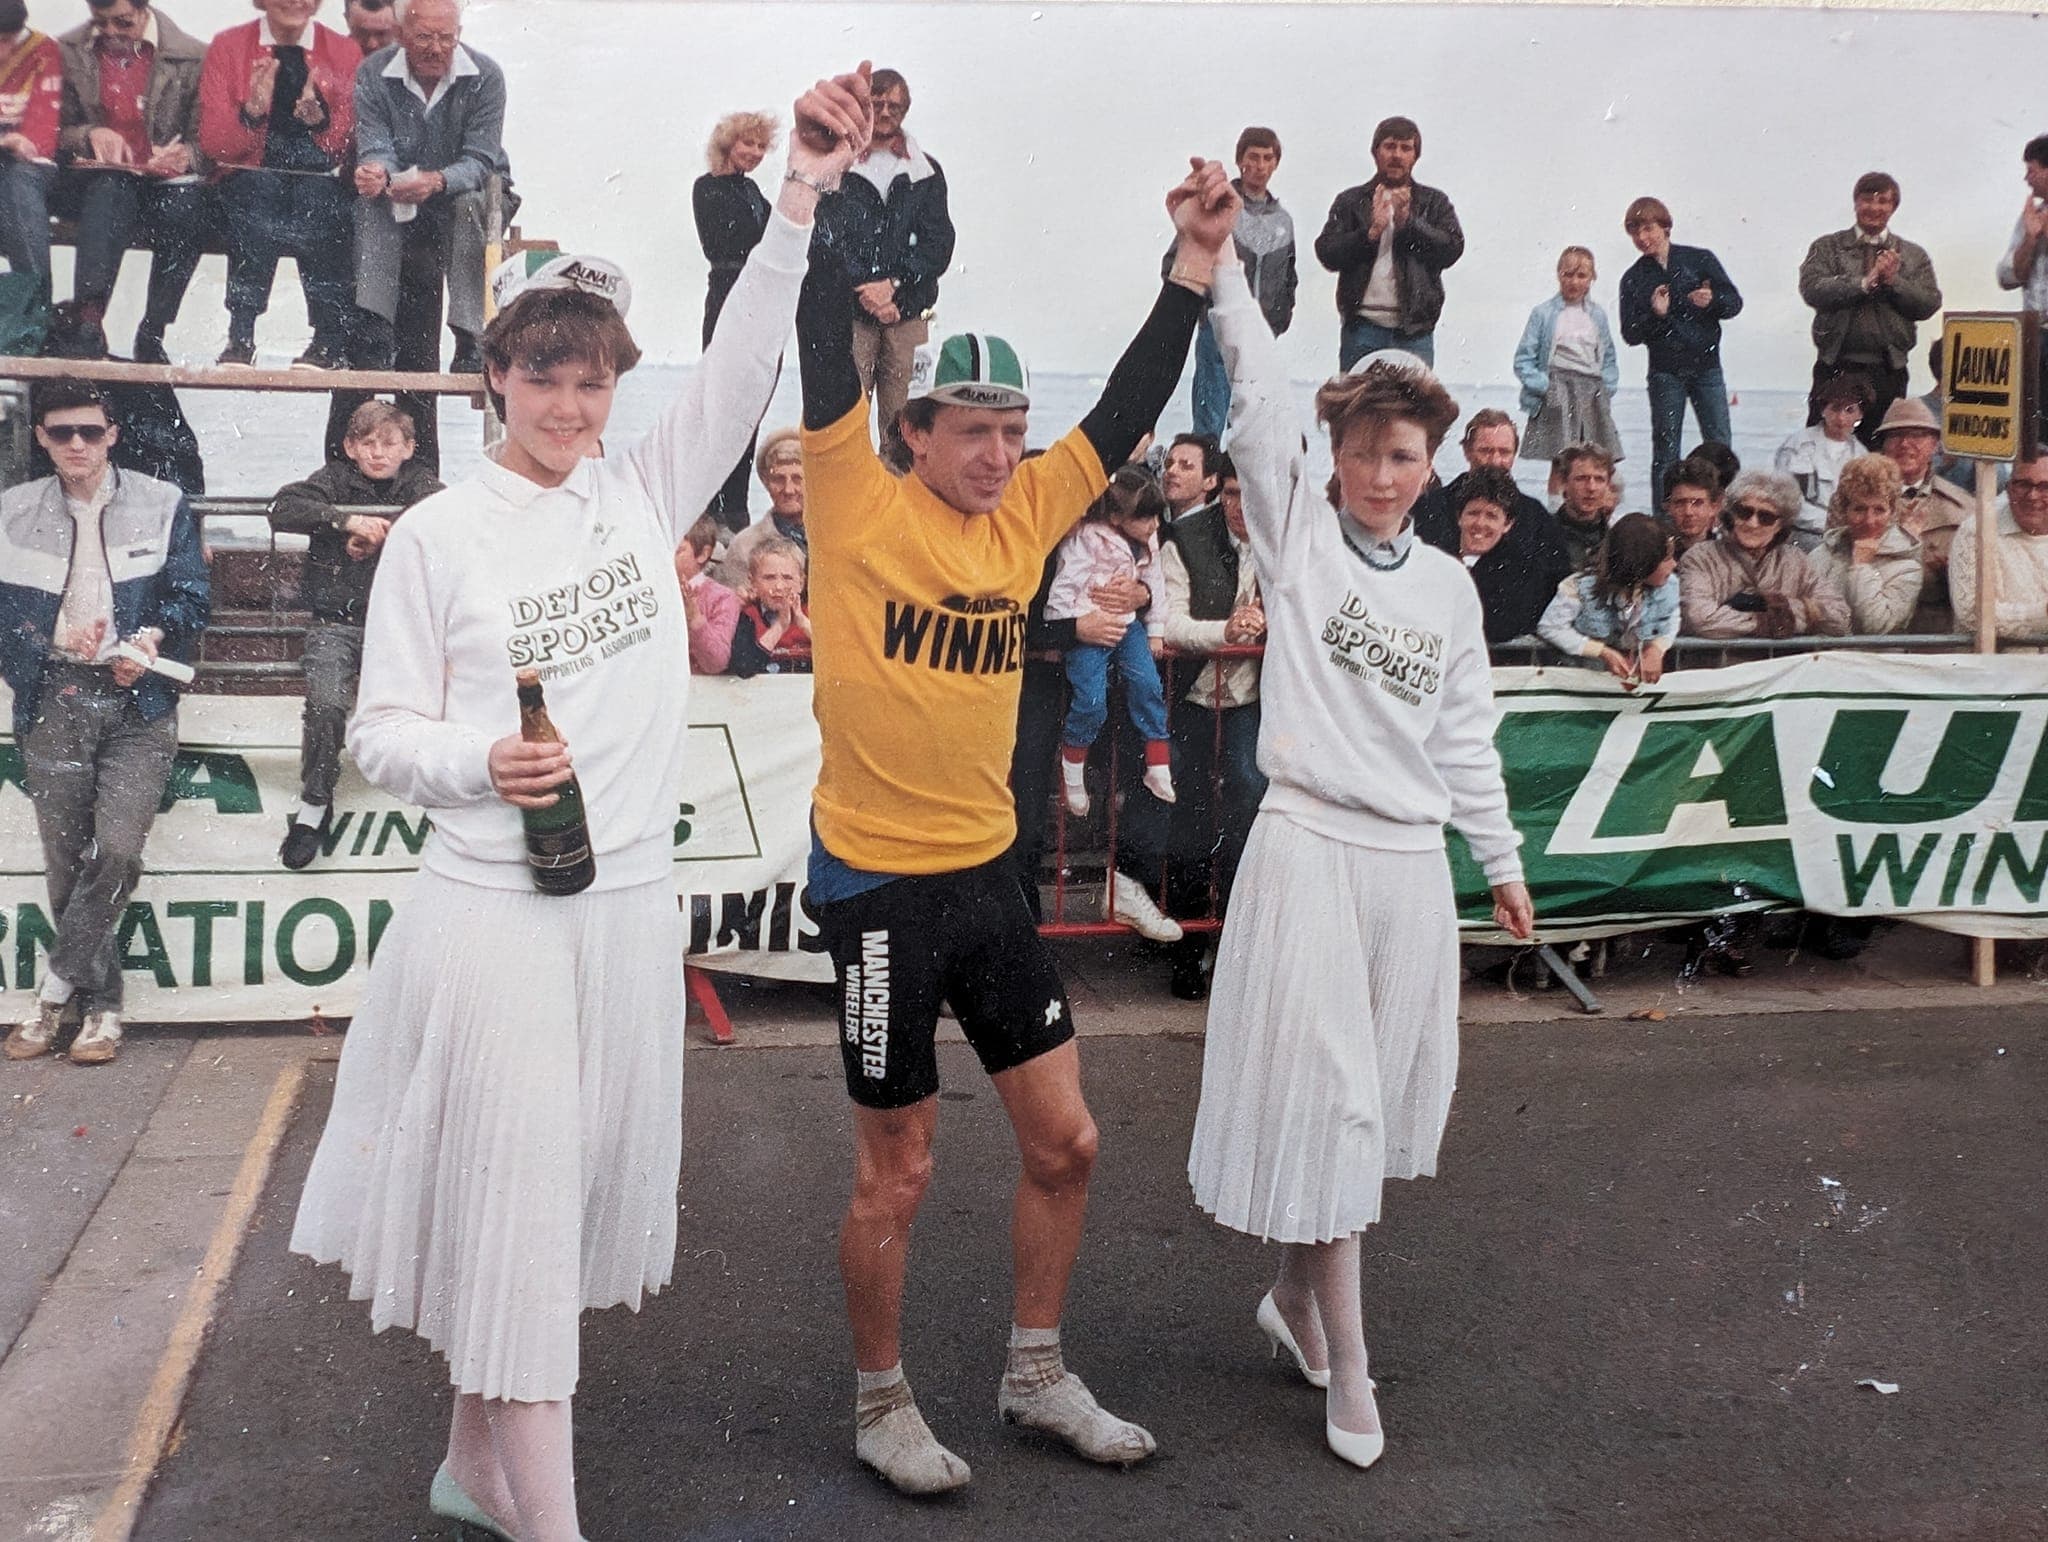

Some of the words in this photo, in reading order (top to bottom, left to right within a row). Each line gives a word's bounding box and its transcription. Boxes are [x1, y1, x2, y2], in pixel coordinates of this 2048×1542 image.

[1950, 332, 2011, 406] LAUNA
[1948, 413, 2011, 439] WINDOWS
[506, 587, 659, 668] SPORTS
[1321, 616, 1441, 694] SPORTS
[845, 963, 861, 1046] WHEELERS
[861, 929, 891, 1081] MANCHESTER
